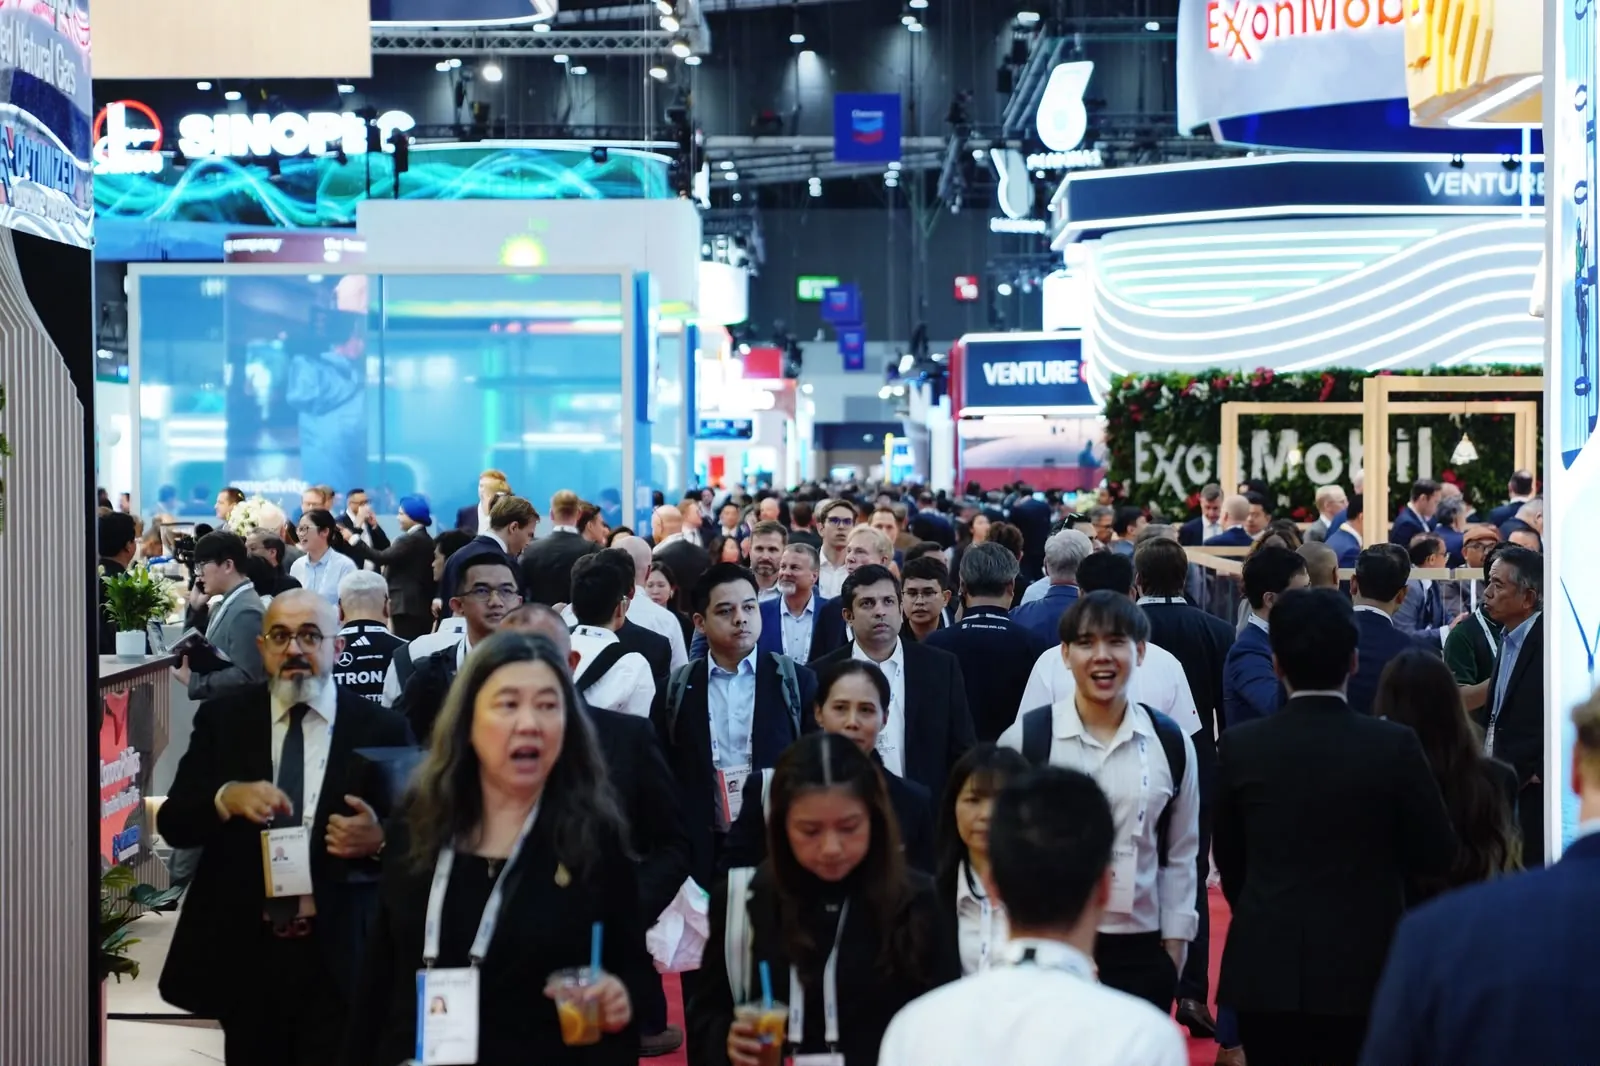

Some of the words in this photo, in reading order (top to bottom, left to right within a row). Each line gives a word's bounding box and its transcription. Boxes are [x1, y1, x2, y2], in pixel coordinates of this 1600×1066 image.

[15, 20, 55, 86] Natural
[55, 43, 77, 96] Gas
[1207, 0, 1404, 60] ExxonMob
[15, 134, 77, 196] OPTIMIZED
[982, 359, 1079, 386] VENTURE
[331, 670, 385, 685] TRON
